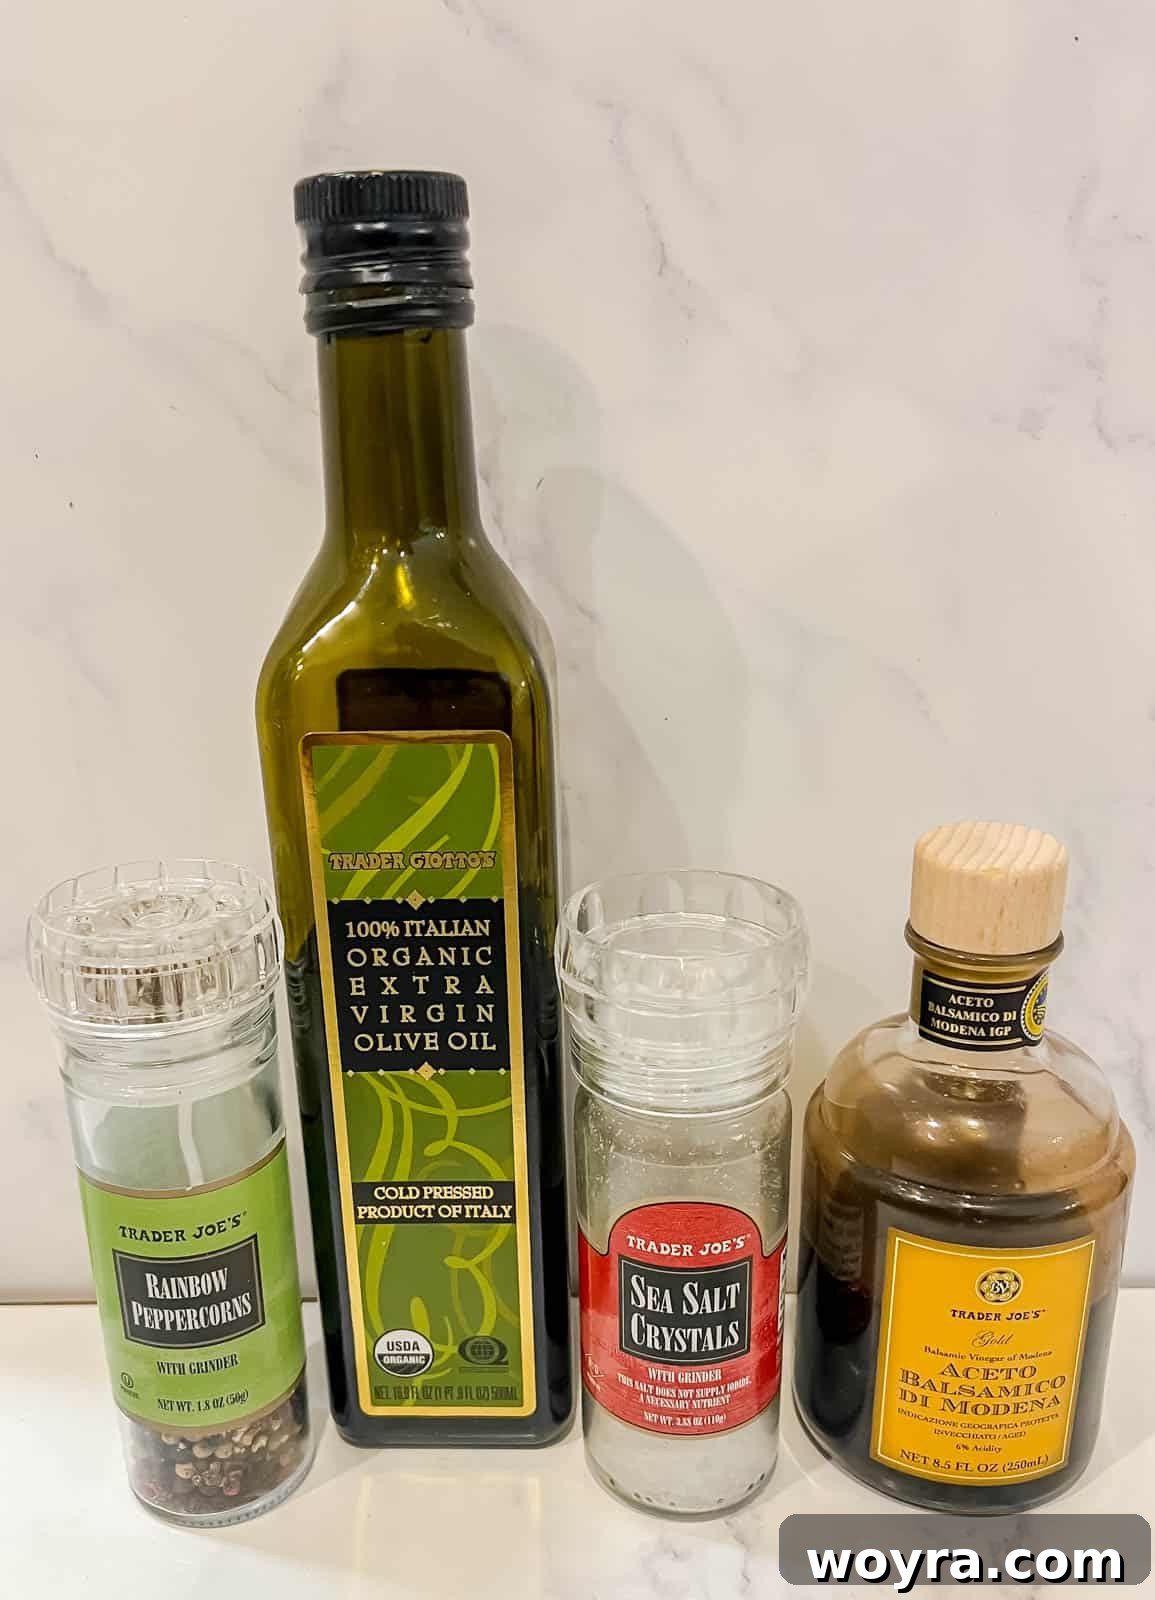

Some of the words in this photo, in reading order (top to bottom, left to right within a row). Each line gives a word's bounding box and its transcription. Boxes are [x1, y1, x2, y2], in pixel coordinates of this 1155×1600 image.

[329, 852, 406, 870] TRADER
[409, 851, 496, 869] GIOTTO'S
[345, 919, 399, 938] 100%
[404, 919, 490, 937] ITALIAN
[347, 947, 492, 967] ORGANIC
[349, 975, 494, 996] EXTRA
[948, 993, 994, 1008] ACETO
[350, 1004, 494, 1024] VIRGIN
[928, 1001, 1000, 1023] BALSAMICO
[1003, 1010, 1017, 1022] DI
[930, 1018, 986, 1037] MODENA
[990, 1025, 1012, 1037] IGP
[354, 1032, 439, 1051] OLIVE
[447, 1032, 496, 1051] OIL
[374, 1186, 420, 1200] COLD
[423, 1185, 494, 1200] PRESSED
[357, 1204, 435, 1219] PRODUCT
[437, 1204, 463, 1218] OF
[464, 1204, 512, 1218] ITALY
[119, 1225, 187, 1243] TRADER
[192, 1213, 242, 1240] JOE'S
[626, 1235, 694, 1257] TRADER
[699, 1235, 746, 1256] JOE'S
[145, 1267, 229, 1300] RAINBOW
[630, 1273, 674, 1314] SEA
[682, 1281, 741, 1315] SALT
[131, 1291, 252, 1332] PEPPERCORNS
[950, 1308, 1001, 1321] TRADER
[1006, 1309, 1041, 1321] JOE'S
[630, 1312, 740, 1353] CRYSTALS
[971, 1331, 1013, 1348] Gold
[386, 1341, 420, 1352] USDA
[924, 1345, 965, 1360] Balsamic
[968, 1352, 1004, 1364] Vinegar
[1007, 1352, 1016, 1361] of
[1018, 1350, 1053, 1361] Modena
[156, 1360, 186, 1376] WITH
[188, 1353, 239, 1375] GRINDER
[383, 1355, 426, 1365] ORGANIC
[647, 1367, 675, 1382] WITH
[678, 1368, 722, 1384] GRINDER
[940, 1362, 1037, 1381] ACETO
[634, 1379, 653, 1394] SALT
[677, 1388, 695, 1399] NOT
[695, 1386, 726, 1399] SUPPLY
[898, 1367, 1067, 1399] BALSAMICO
[157, 1398, 174, 1411] NET
[176, 1400, 195, 1412] WT.
[197, 1399, 211, 1412] 1.8
[212, 1396, 225, 1409] OZ
[646, 1395, 692, 1410] NECESSARY
[692, 1394, 731, 1409] NUTRIENT
[898, 1388, 930, 1408] DI
[940, 1394, 1062, 1416] MODENA
[644, 1411, 659, 1423] NET
[899, 1449, 930, 1466] NET
[932, 1460, 951, 1470] 8.5
[955, 1461, 974, 1472] FL
[977, 1462, 999, 1473] OZ
